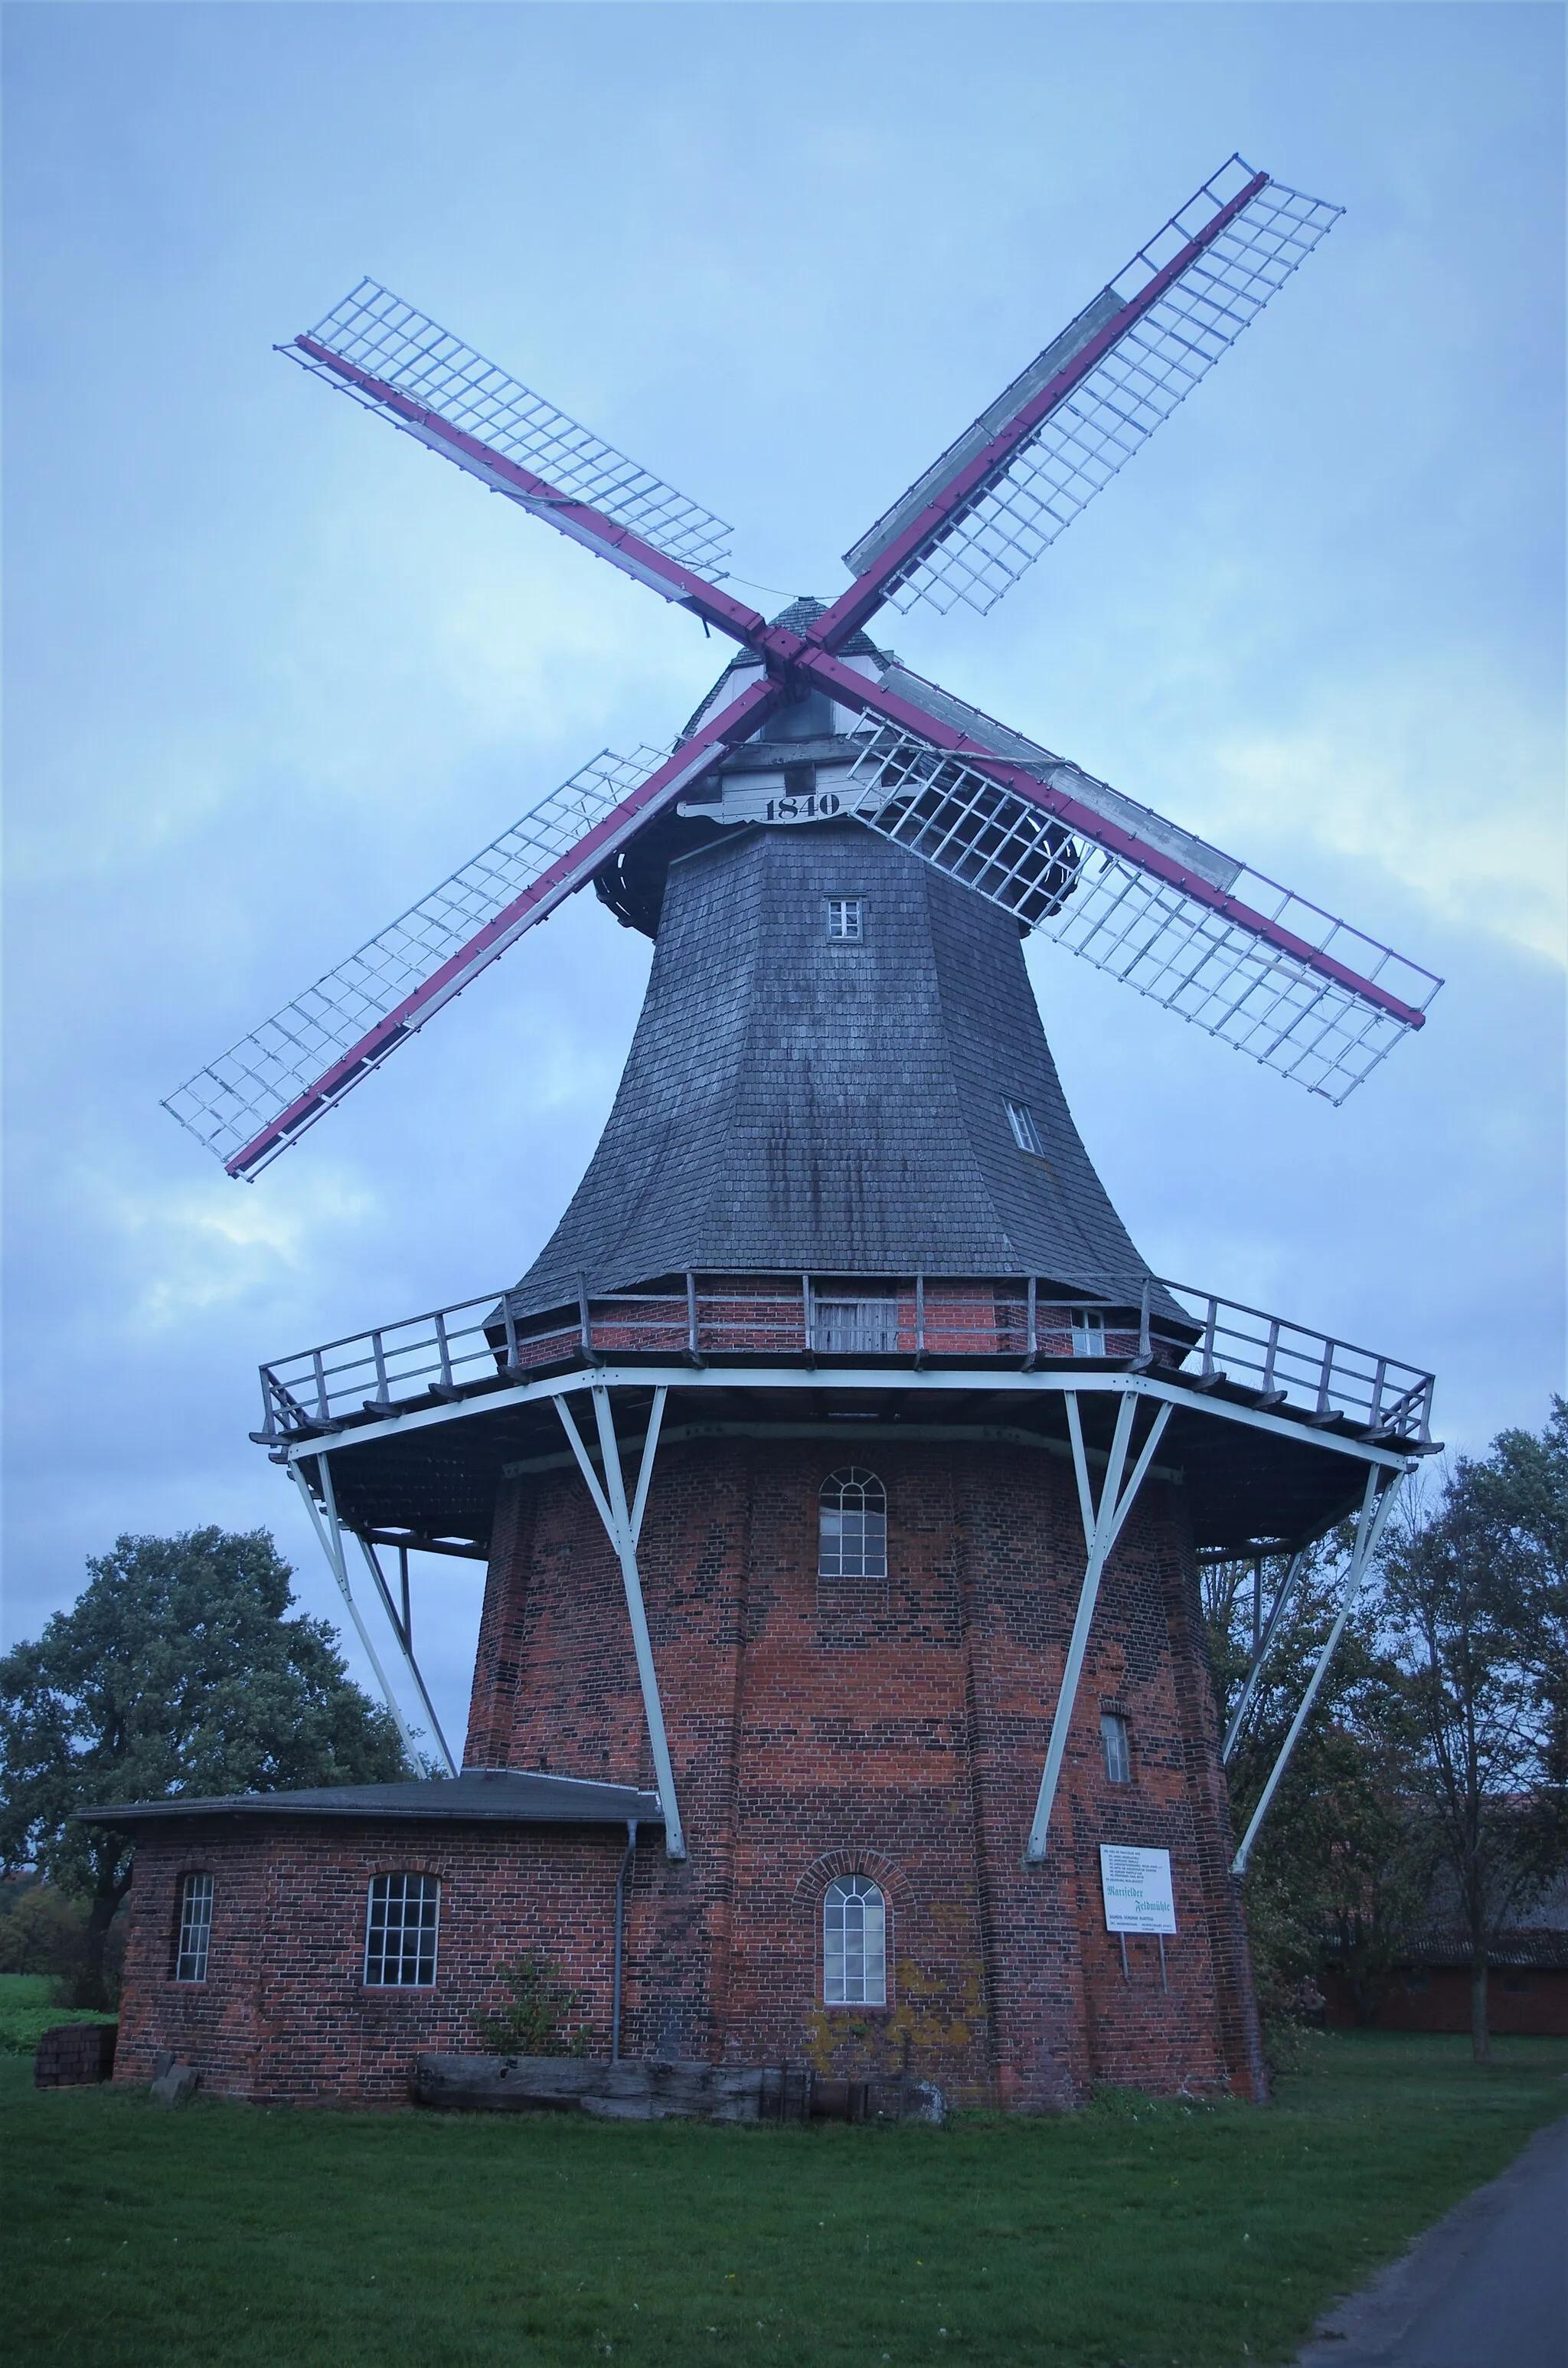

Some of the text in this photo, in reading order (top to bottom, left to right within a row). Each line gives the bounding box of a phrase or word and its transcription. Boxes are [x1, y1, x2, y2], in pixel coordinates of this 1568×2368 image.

[764, 794, 839, 821] 1840
[1107, 1886, 1144, 1898] Martfelder
[1135, 1900, 1170, 1912] Feldmühle
